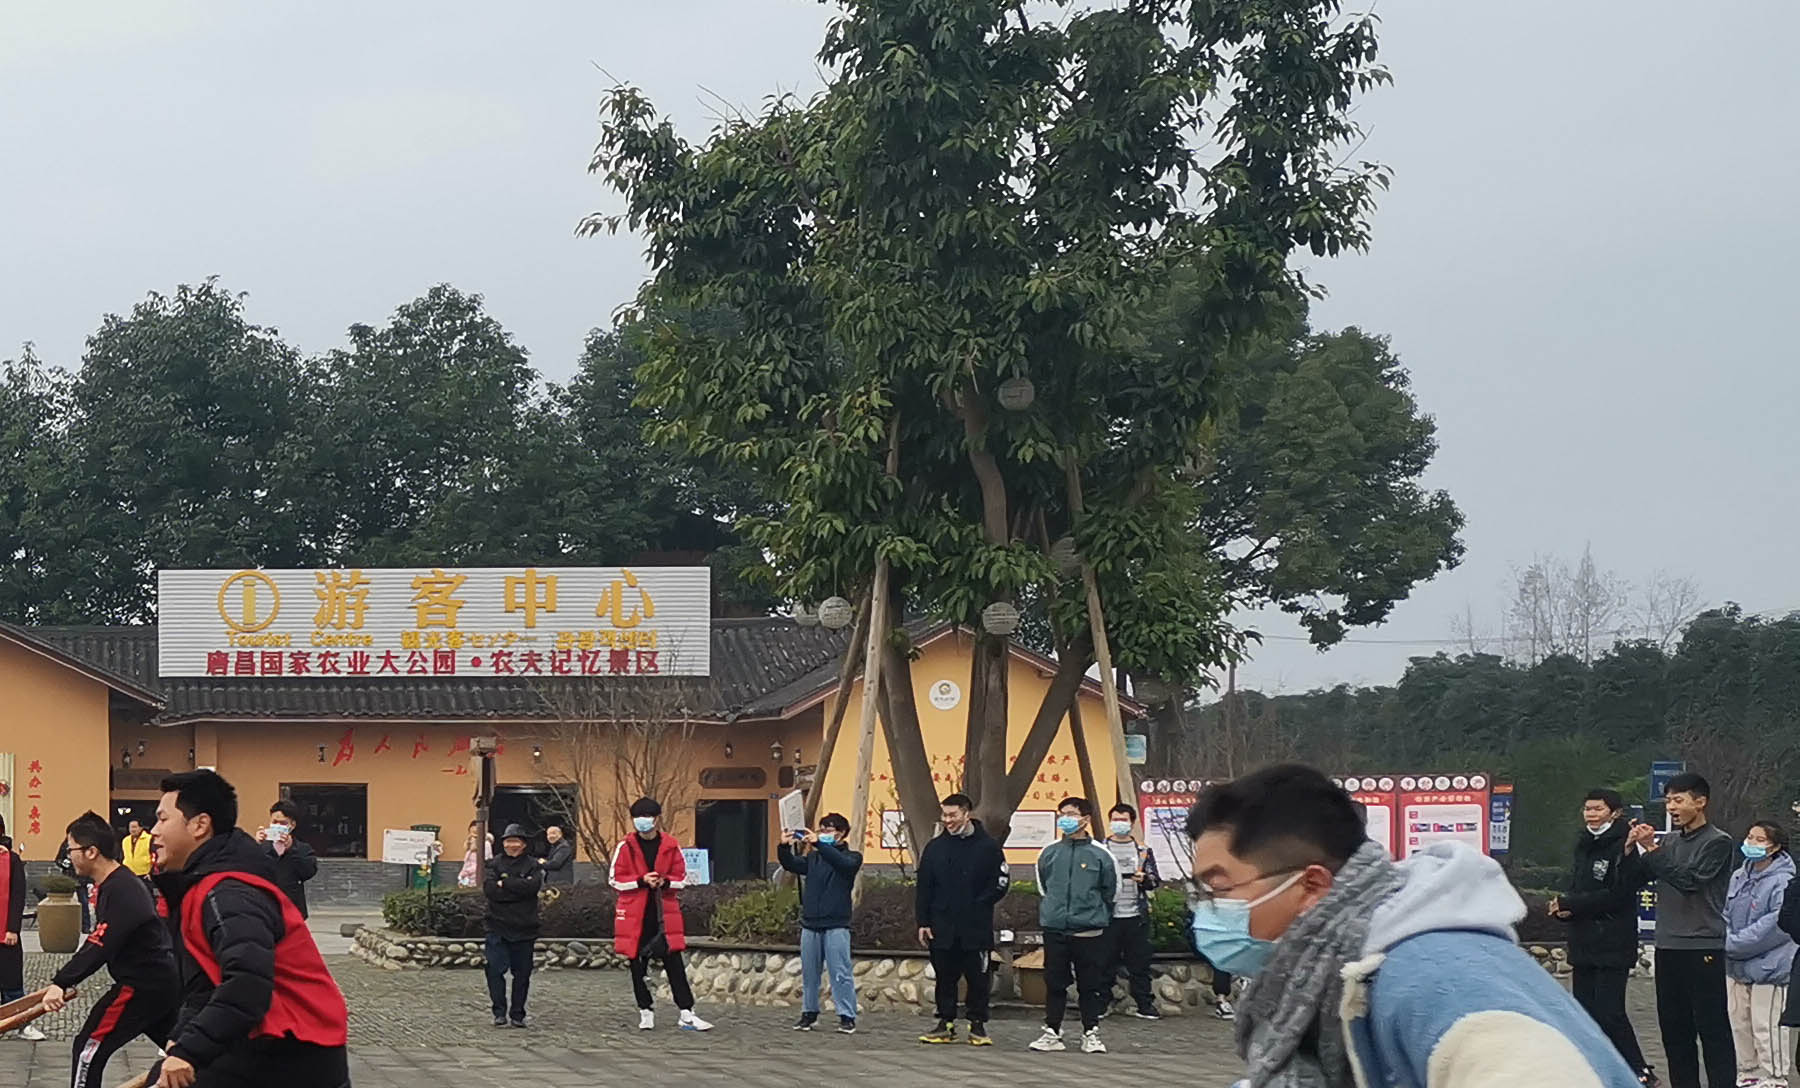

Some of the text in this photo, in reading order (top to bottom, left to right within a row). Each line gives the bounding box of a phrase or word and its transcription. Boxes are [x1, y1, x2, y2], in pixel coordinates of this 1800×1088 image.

[313, 568, 656, 630] 游客中心
[224, 630, 374, 648] Tourist Centre
